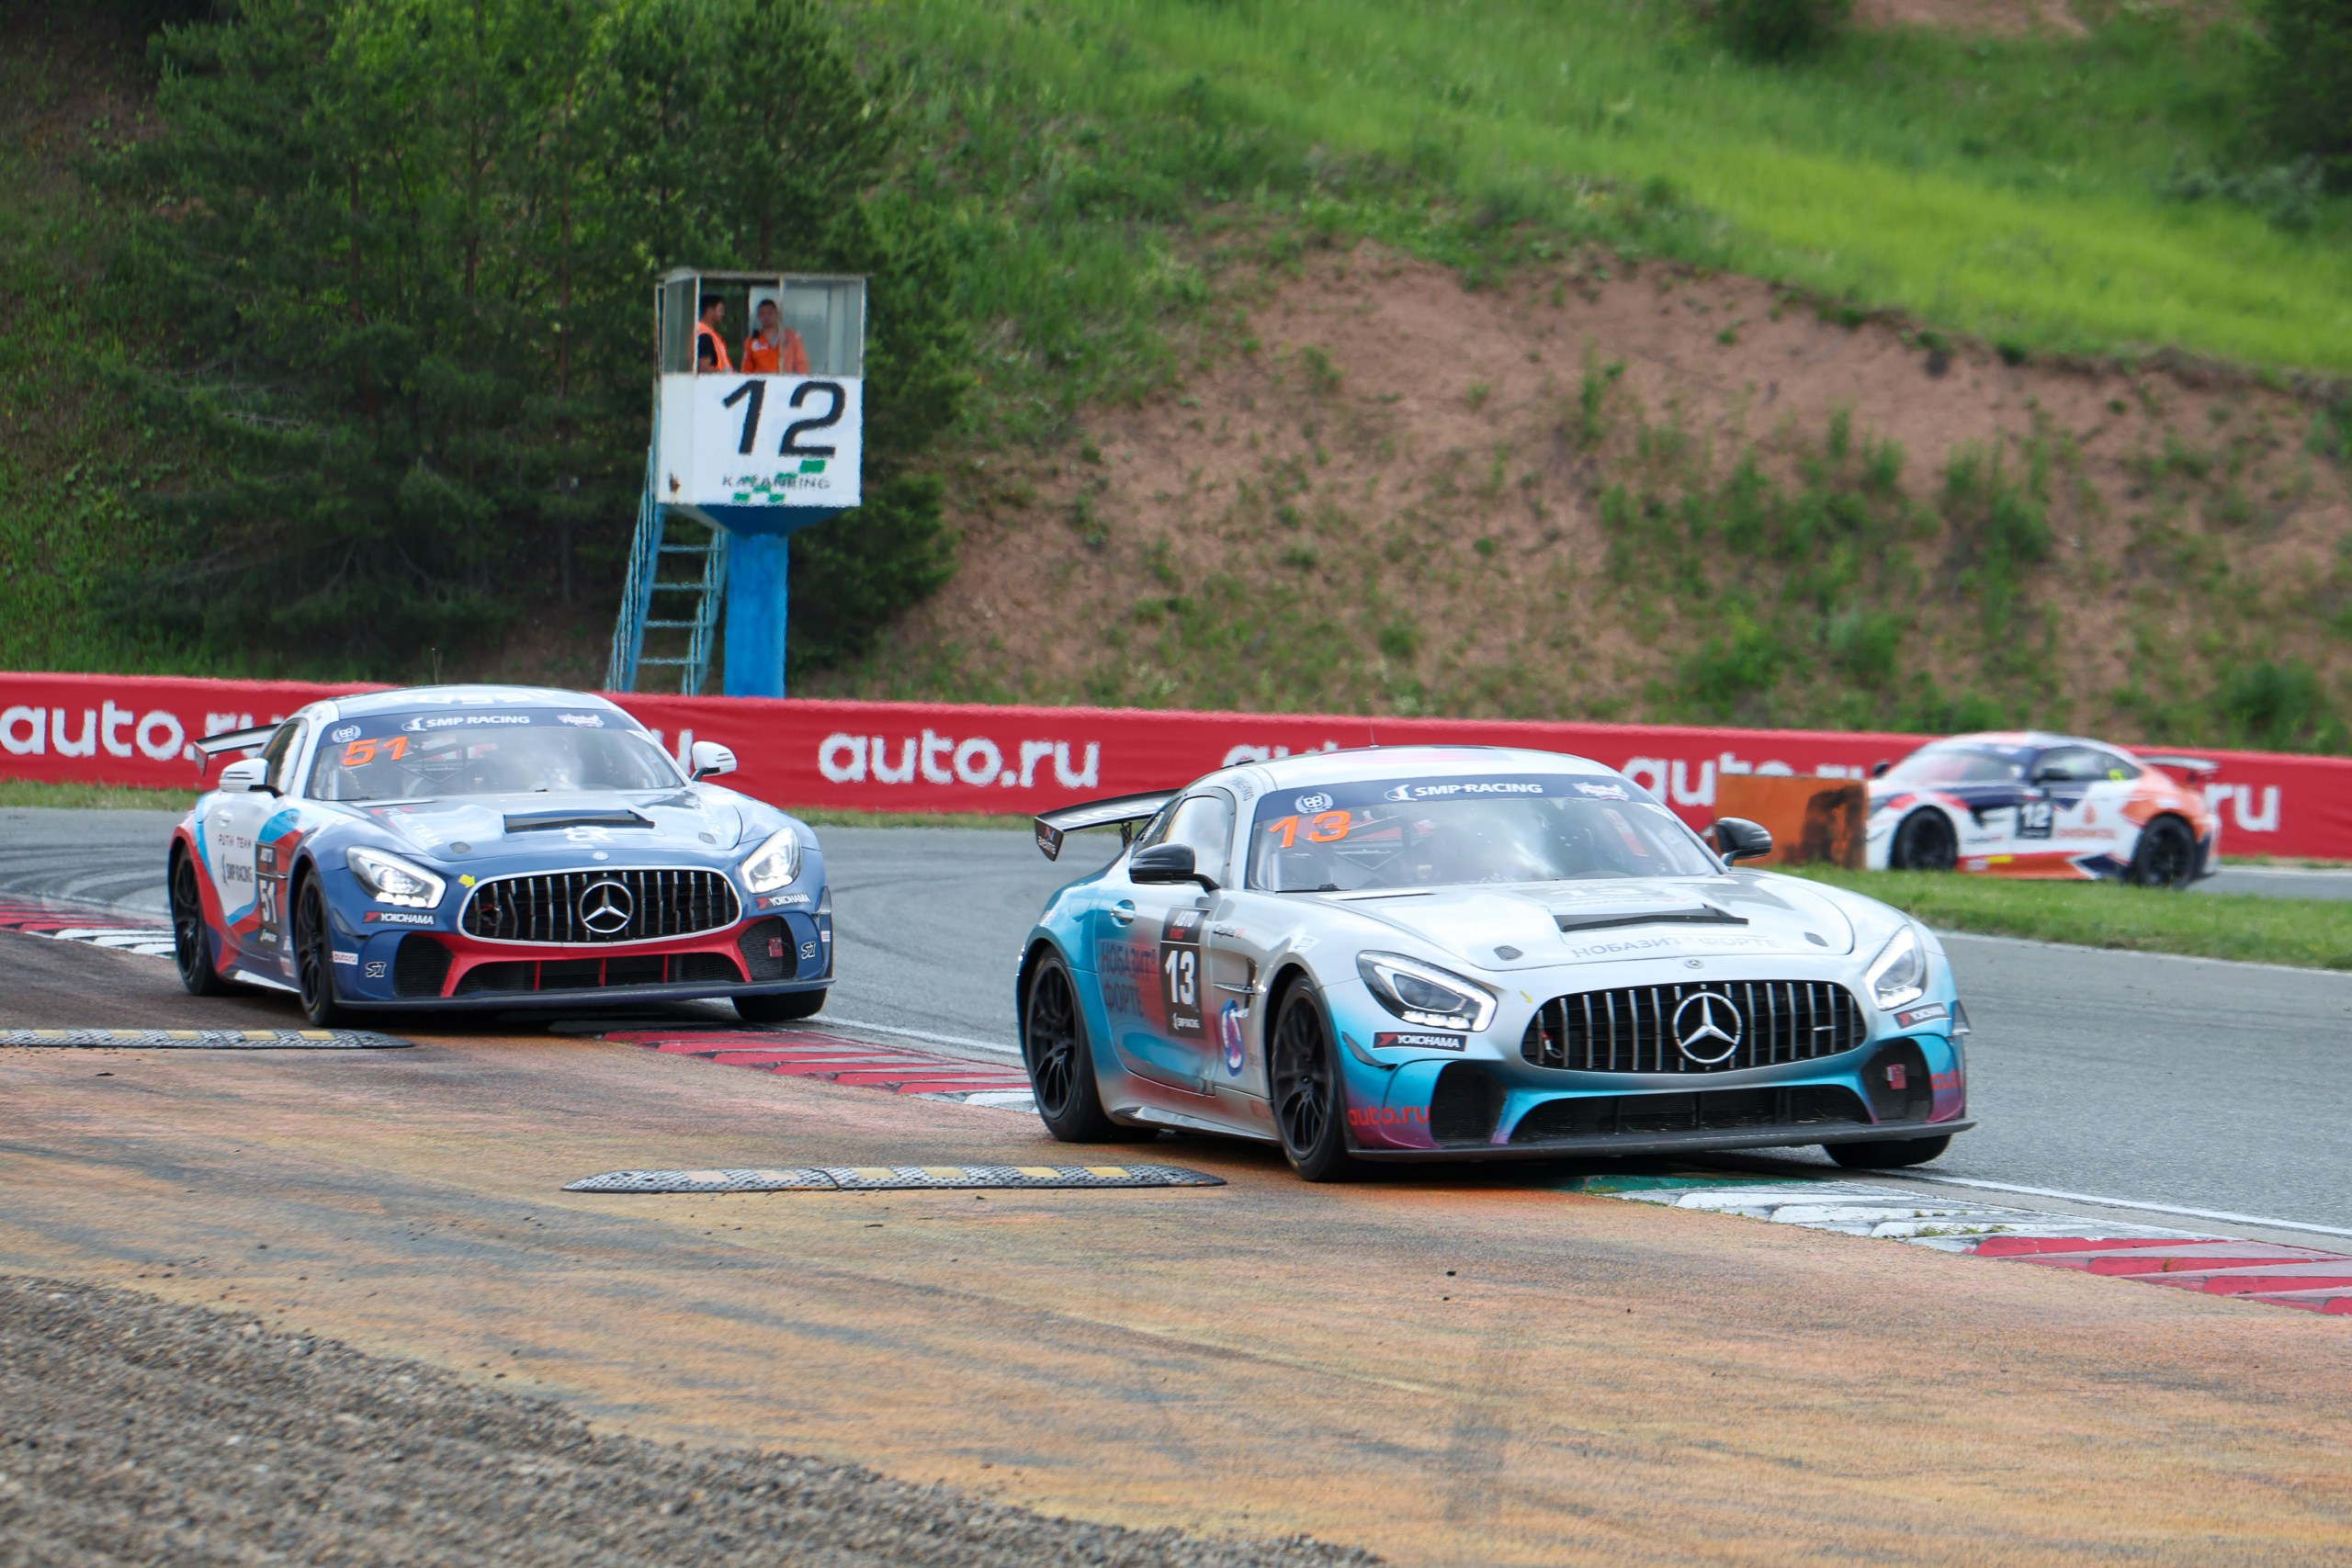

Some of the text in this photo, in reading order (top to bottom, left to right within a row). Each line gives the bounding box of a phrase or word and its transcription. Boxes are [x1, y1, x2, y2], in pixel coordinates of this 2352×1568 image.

[722, 378, 846, 457] 12
[426, 716, 530, 728] SMP RACING
[343, 736, 409, 766] 51
[819, 728, 1101, 789] auto.ru
[1415, 783, 1544, 796] SMP RACING
[2021, 802, 2052, 828] 12
[1269, 810, 1351, 849] 13
[259, 879, 277, 924] 51
[769, 893, 811, 906] YOKOHAMA
[380, 914, 435, 925] YOKOHAMA
[1165, 950, 1195, 1006] 13
[1396, 1034, 1461, 1049] YOKOHAMA
[1348, 1105, 1430, 1127] auto.ru
